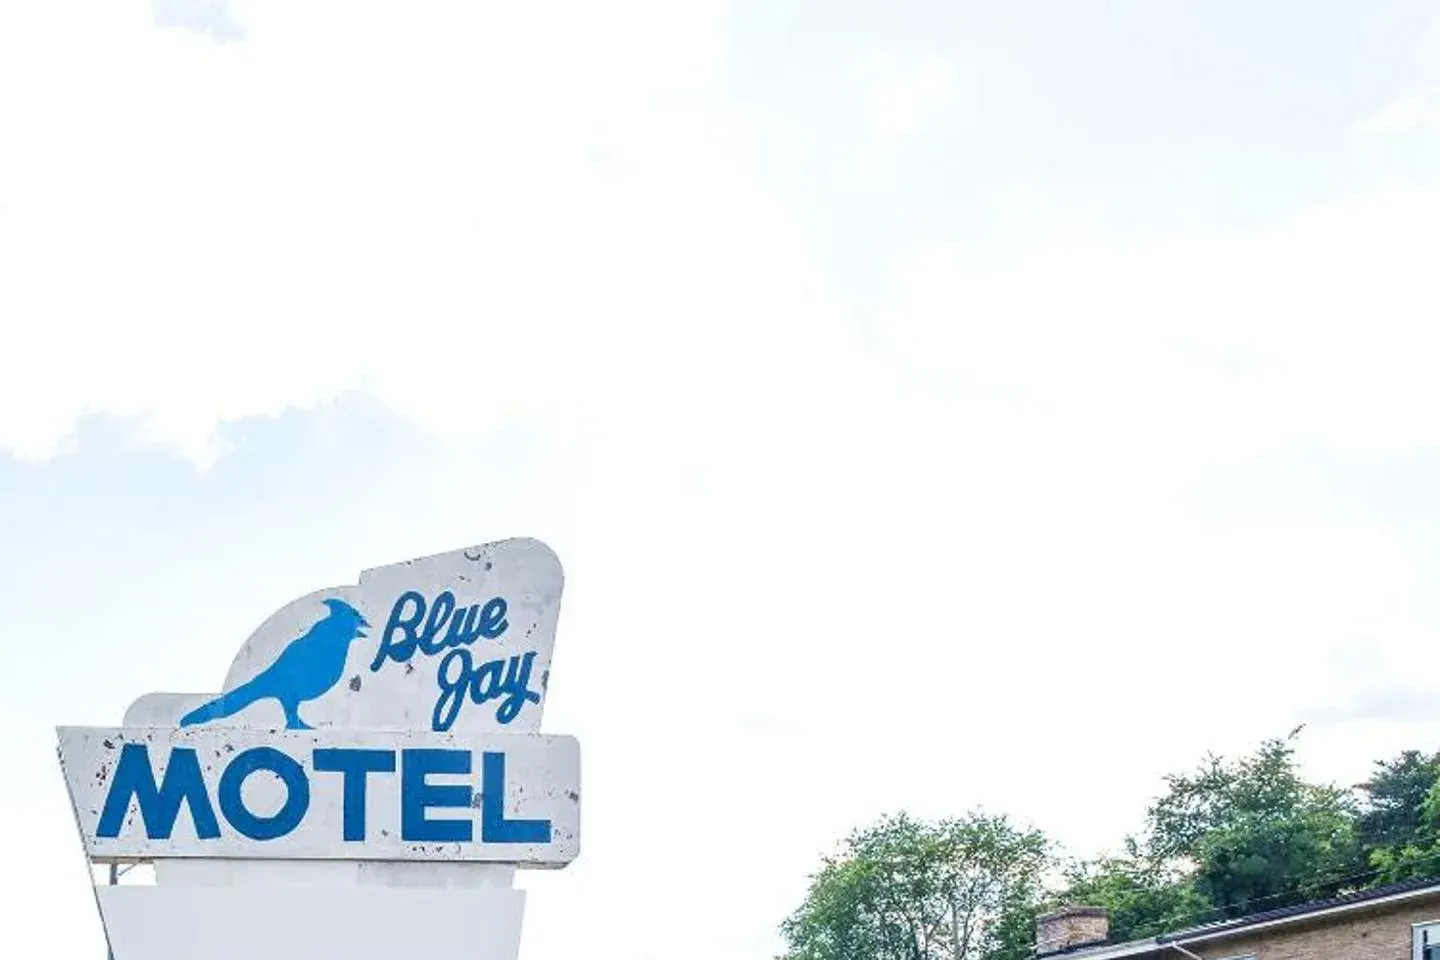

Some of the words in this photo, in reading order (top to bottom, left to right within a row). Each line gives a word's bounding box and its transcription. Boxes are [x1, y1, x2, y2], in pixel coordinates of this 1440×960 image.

[370, 590, 508, 671] Blue
[432, 648, 540, 732] Jay
[96, 744, 551, 843] MOTEL
